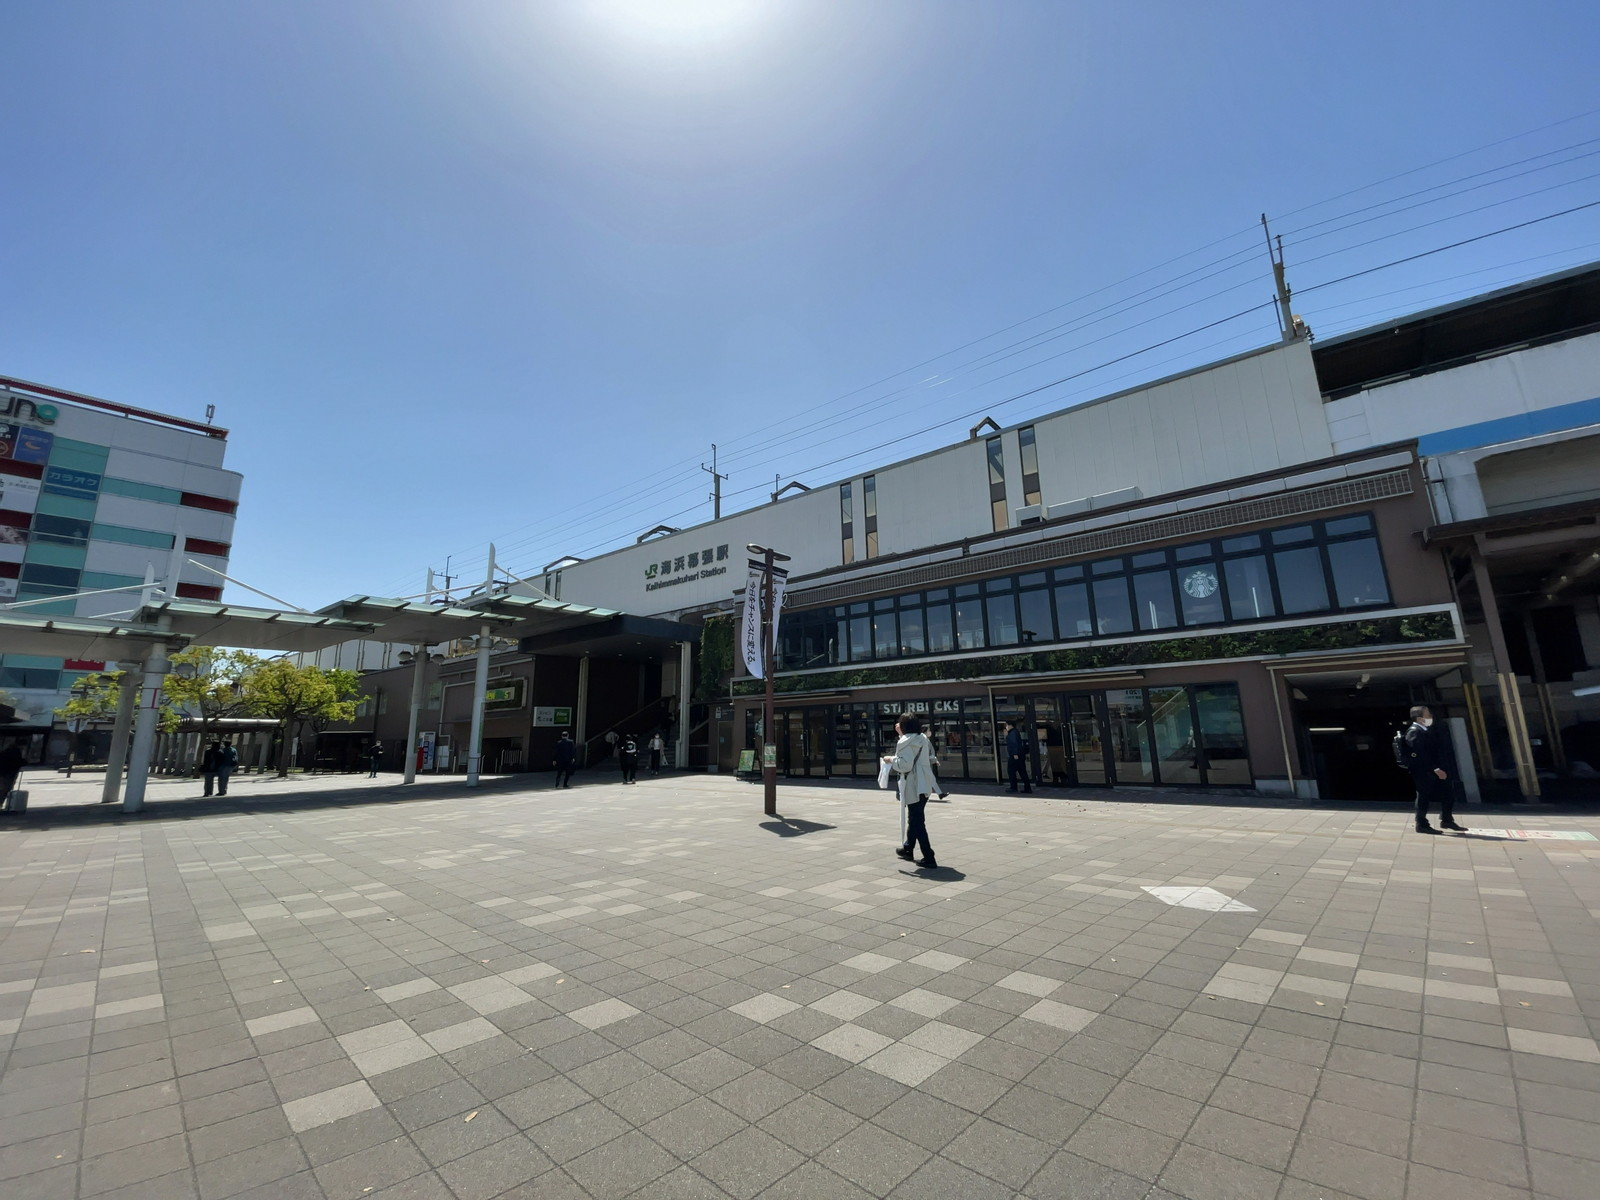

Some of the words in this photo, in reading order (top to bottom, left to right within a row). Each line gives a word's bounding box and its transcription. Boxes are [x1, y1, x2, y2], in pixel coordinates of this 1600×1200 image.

[645, 564, 658, 576] JR
[661, 544, 729, 575] 海浜幕張駅
[646, 571, 699, 592] Kaihimmakuhari
[700, 566, 727, 579] Station
